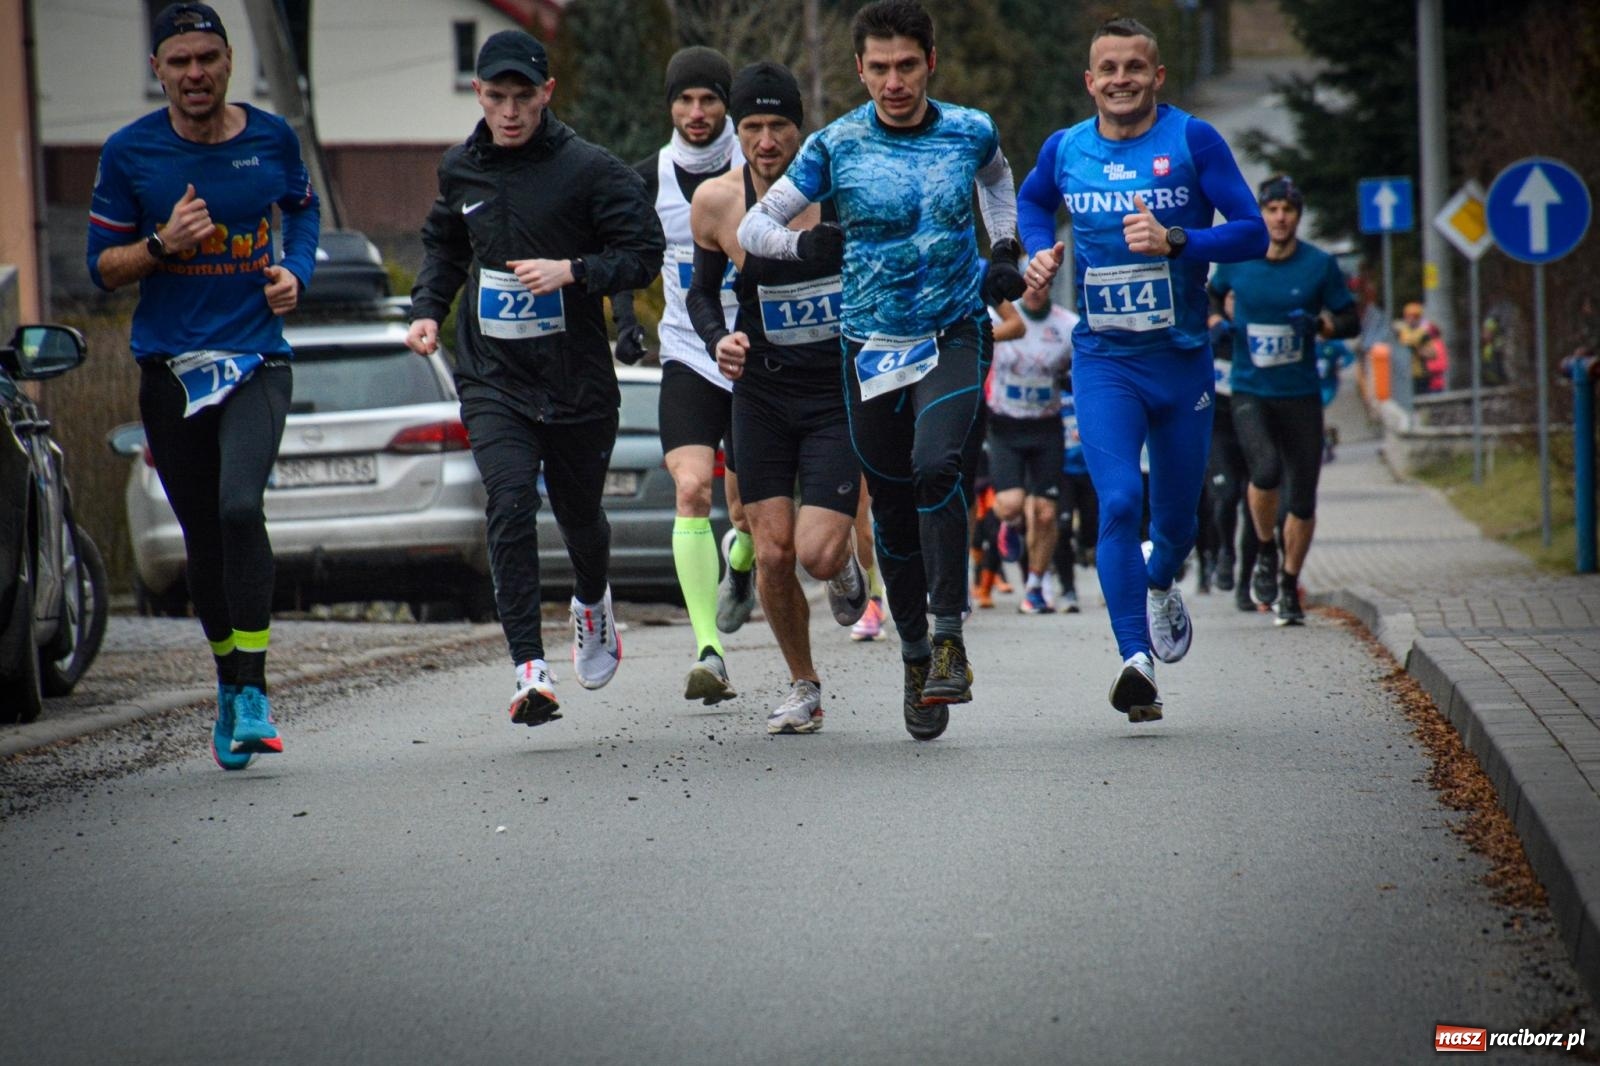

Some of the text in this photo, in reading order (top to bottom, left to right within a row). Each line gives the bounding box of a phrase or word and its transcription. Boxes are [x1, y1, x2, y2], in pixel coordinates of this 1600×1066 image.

[1063, 186, 1190, 214] RUNNERS
[498, 291, 537, 319] 22
[778, 296, 838, 328] 121
[1098, 282, 1158, 313] 114
[201, 357, 243, 392] 74
[876, 348, 910, 373] 67
